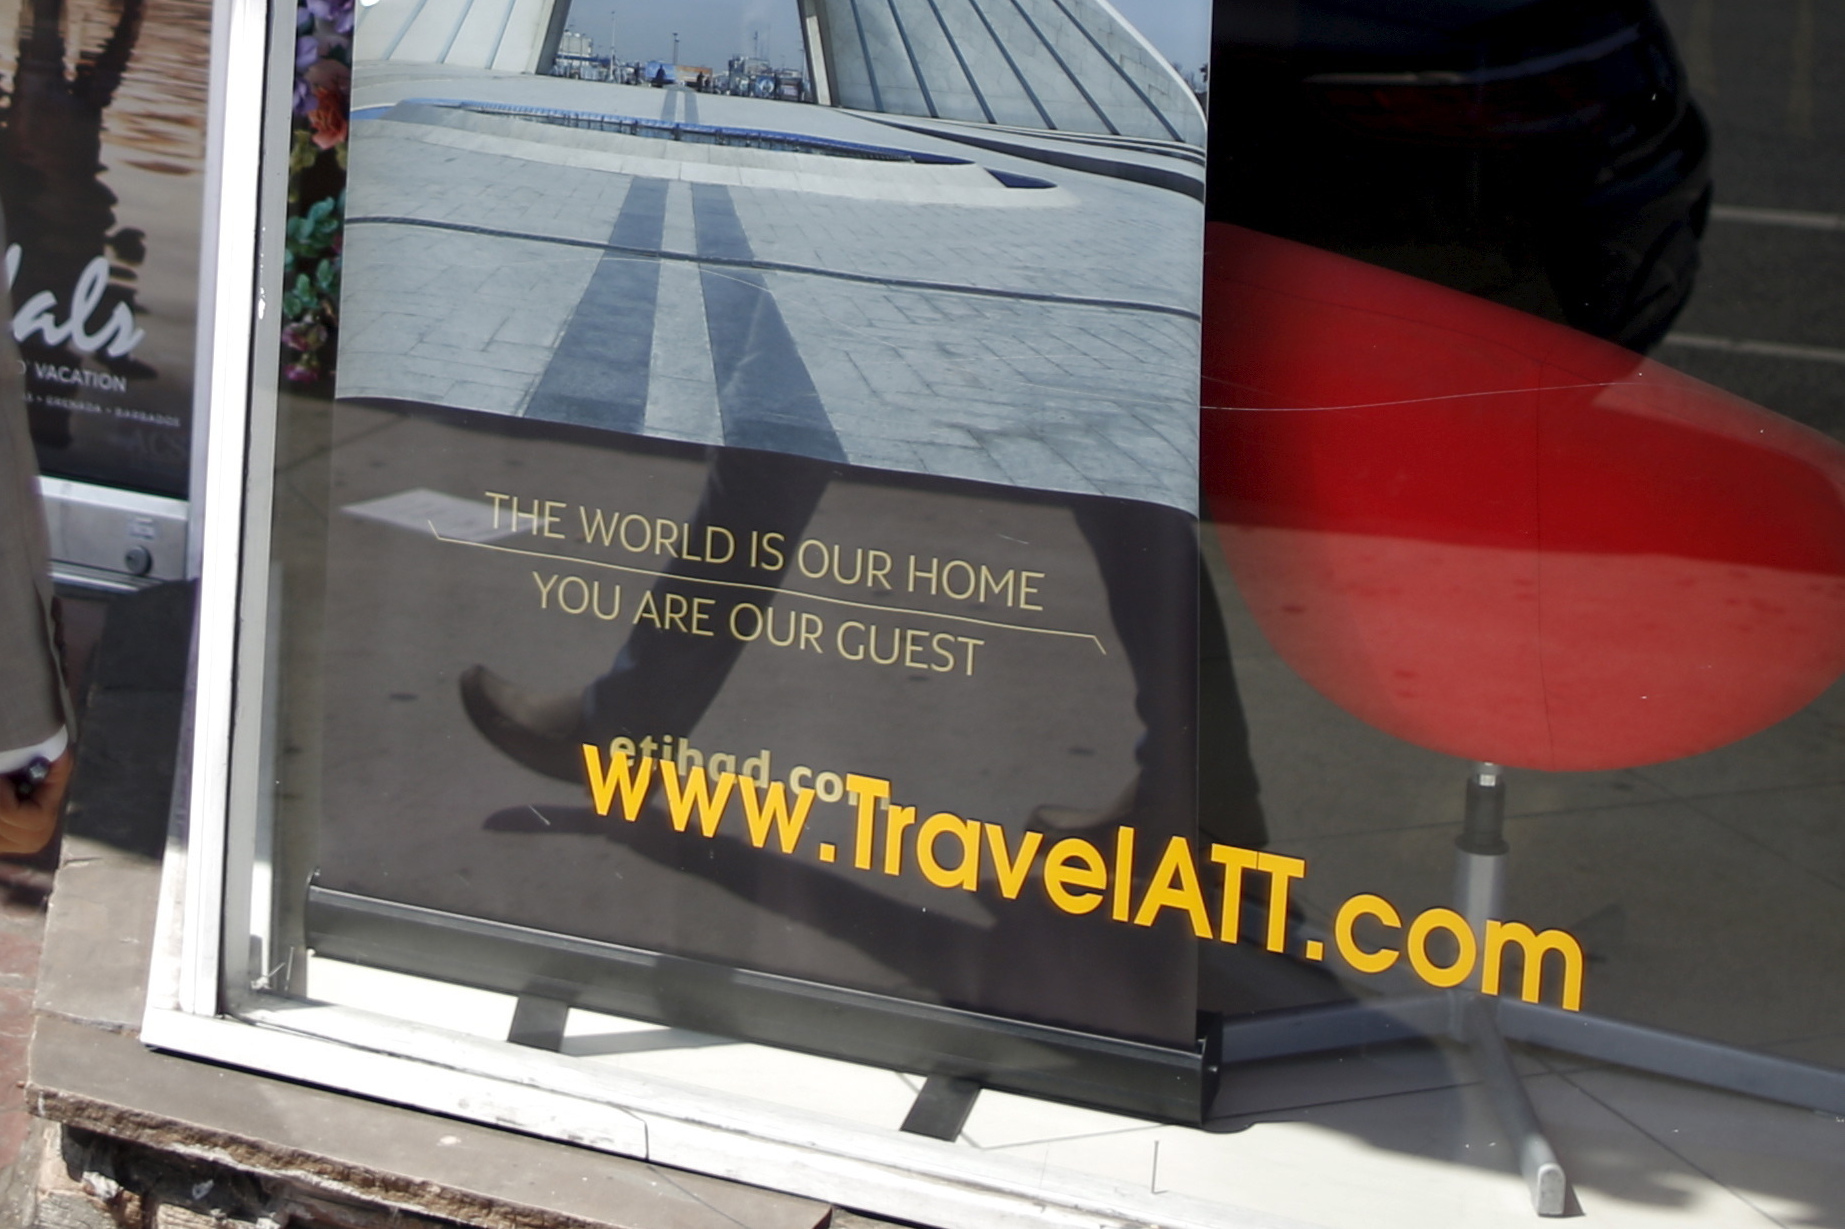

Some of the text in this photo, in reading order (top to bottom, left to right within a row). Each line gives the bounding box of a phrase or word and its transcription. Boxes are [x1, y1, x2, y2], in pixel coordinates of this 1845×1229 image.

[34, 361, 128, 393] VACATION
[484, 490, 1047, 612] THE WORLD IS OUR HOME
[531, 570, 985, 677] YOU ARE OUR GUEST
[582, 742, 1585, 1011] www.TravelATT.com
